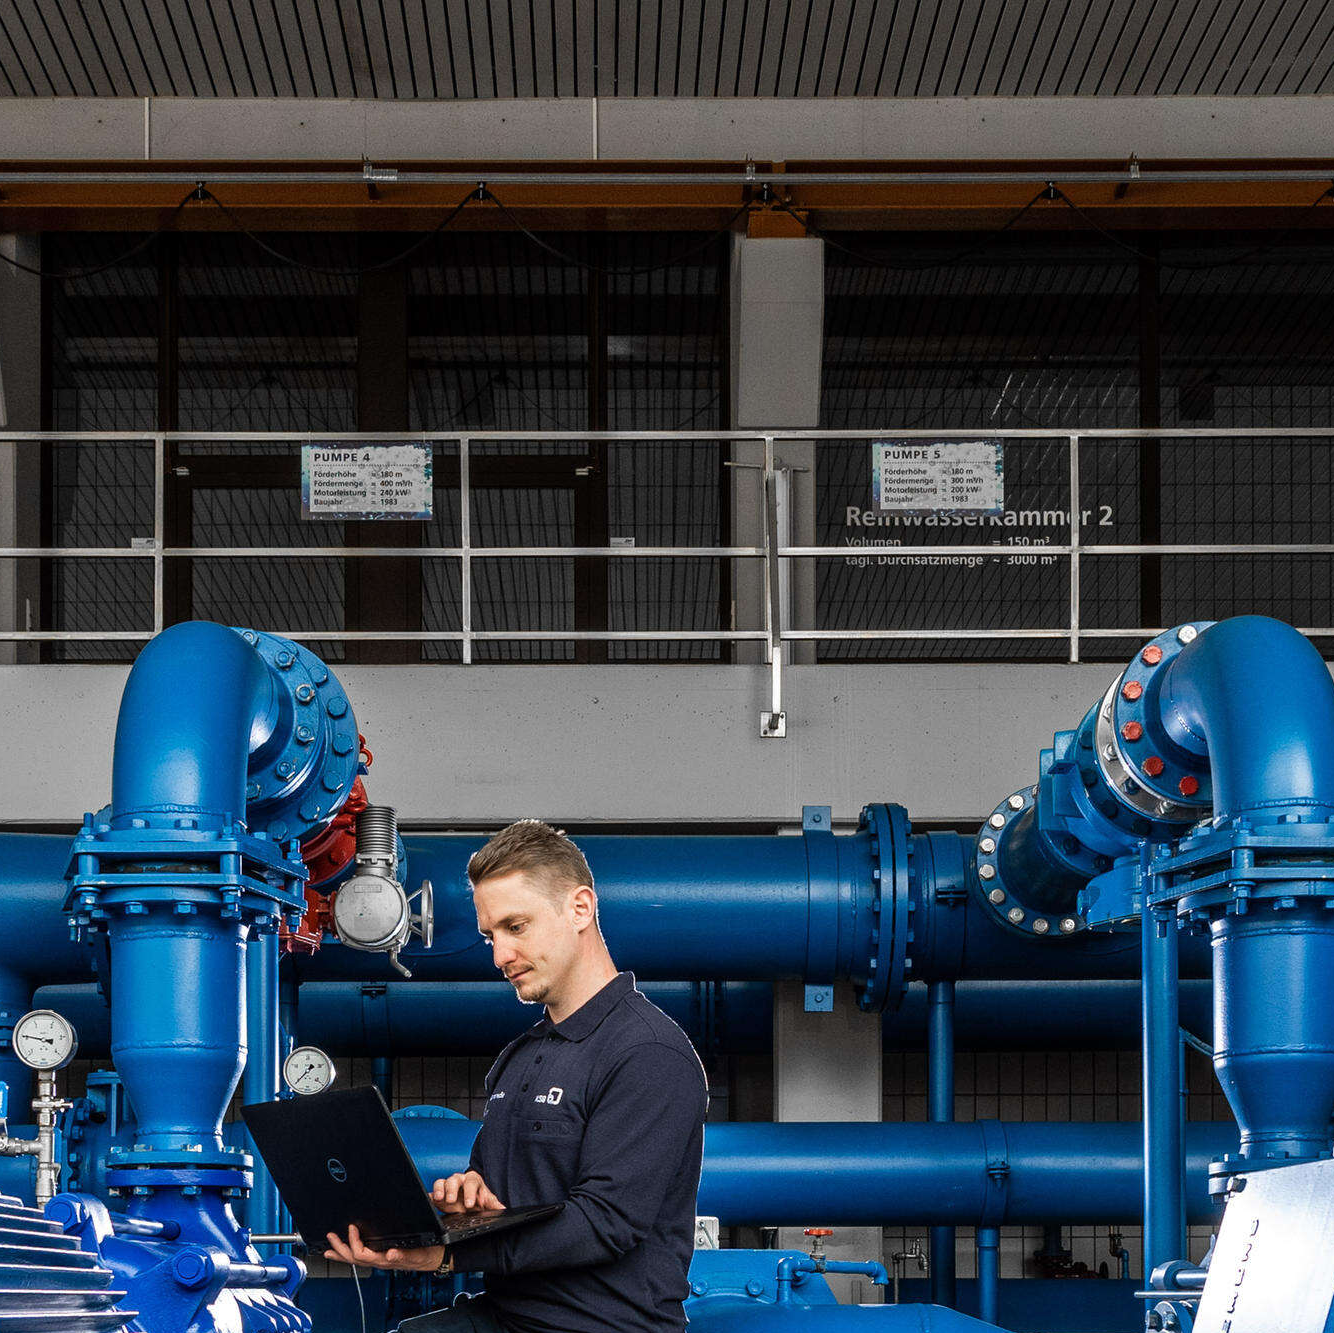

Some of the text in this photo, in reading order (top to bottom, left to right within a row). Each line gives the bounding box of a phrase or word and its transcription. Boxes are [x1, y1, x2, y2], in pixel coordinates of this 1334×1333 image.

[885, 451, 940, 459] PUMPE 5
[885, 496, 913, 504] Baujahr
[1099, 506, 1113, 526] 2
[846, 537, 901, 547] Volumen
[1008, 537, 1029, 546] 150
[878, 556, 983, 567] Durchsatzmenge
[1007, 556, 1037, 565] 3000
